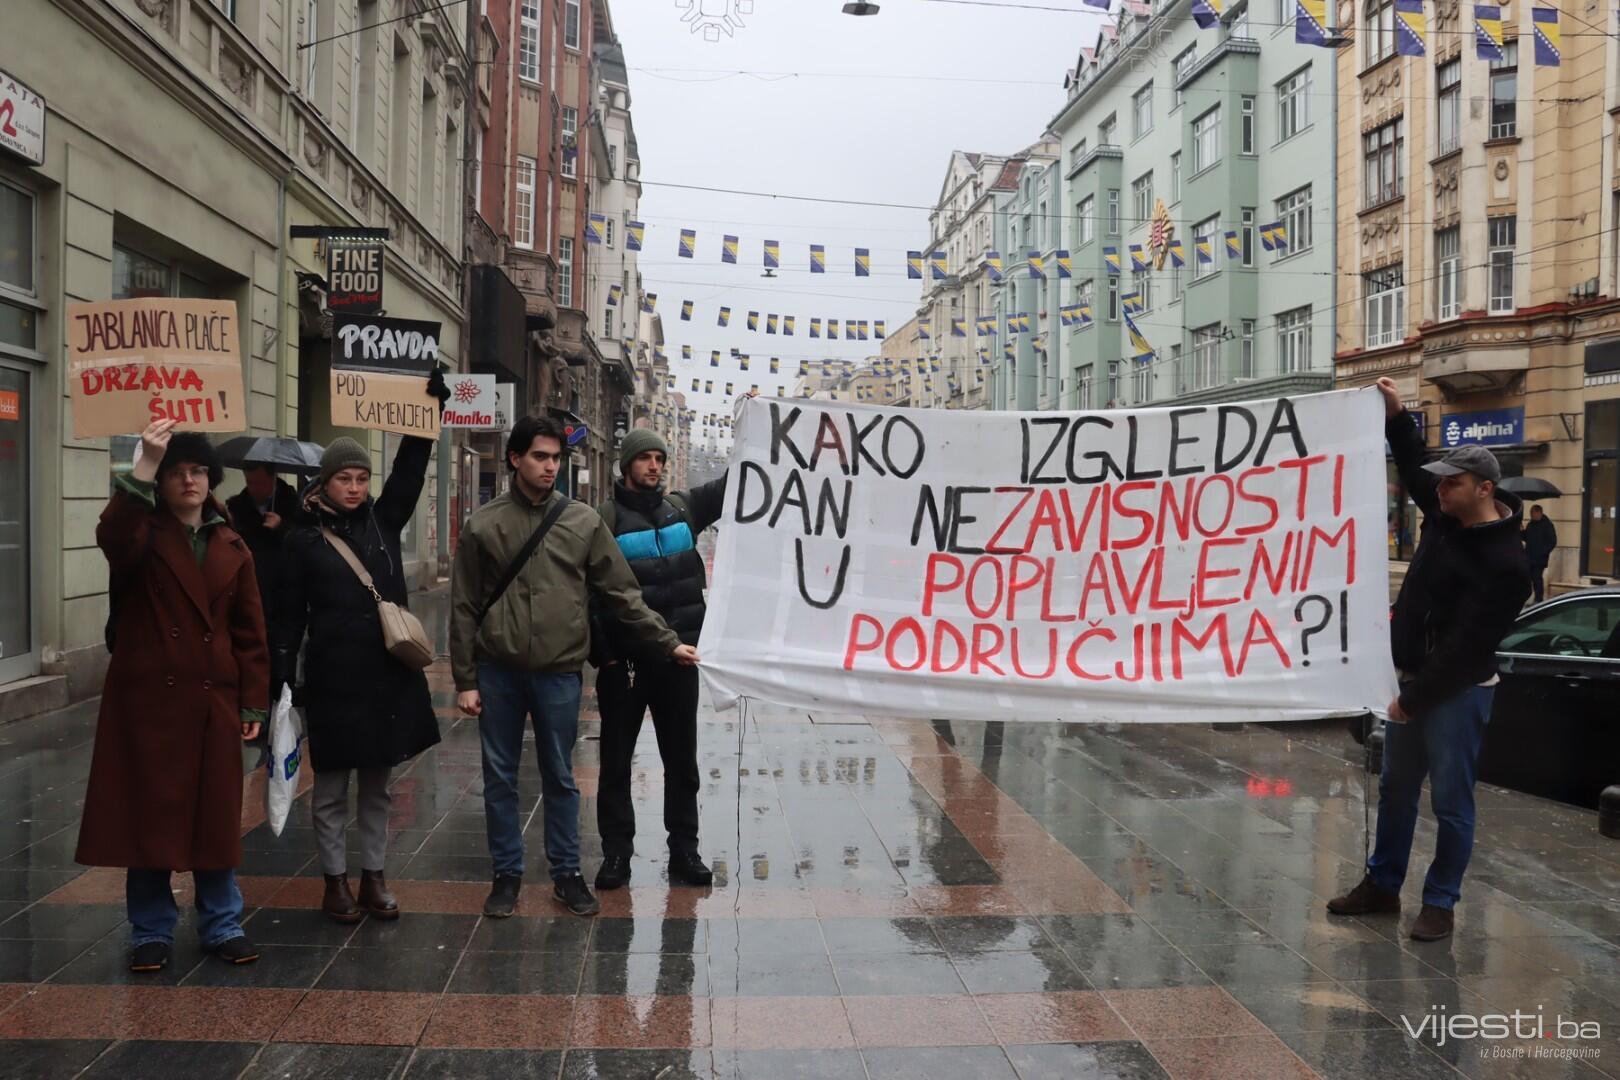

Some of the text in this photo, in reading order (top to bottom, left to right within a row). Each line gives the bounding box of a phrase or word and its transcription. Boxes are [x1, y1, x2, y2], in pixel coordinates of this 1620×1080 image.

[331, 248, 379, 271] FINE
[331, 271, 379, 292] FOOD
[75, 309, 231, 353] JABLANICA PLAČE
[338, 323, 439, 360] PRAVDA
[81, 363, 204, 396] DRŽAVA
[336, 373, 366, 397] POD
[355, 400, 434, 430] KAMENJEM
[443, 410, 492, 425] Planika
[769, 398, 1308, 485] KAKO IZGLEDA
[1462, 421, 1514, 441] alpina
[735, 454, 1345, 555] DAN NEZAVISNOSTI
[795, 537, 851, 610] U
